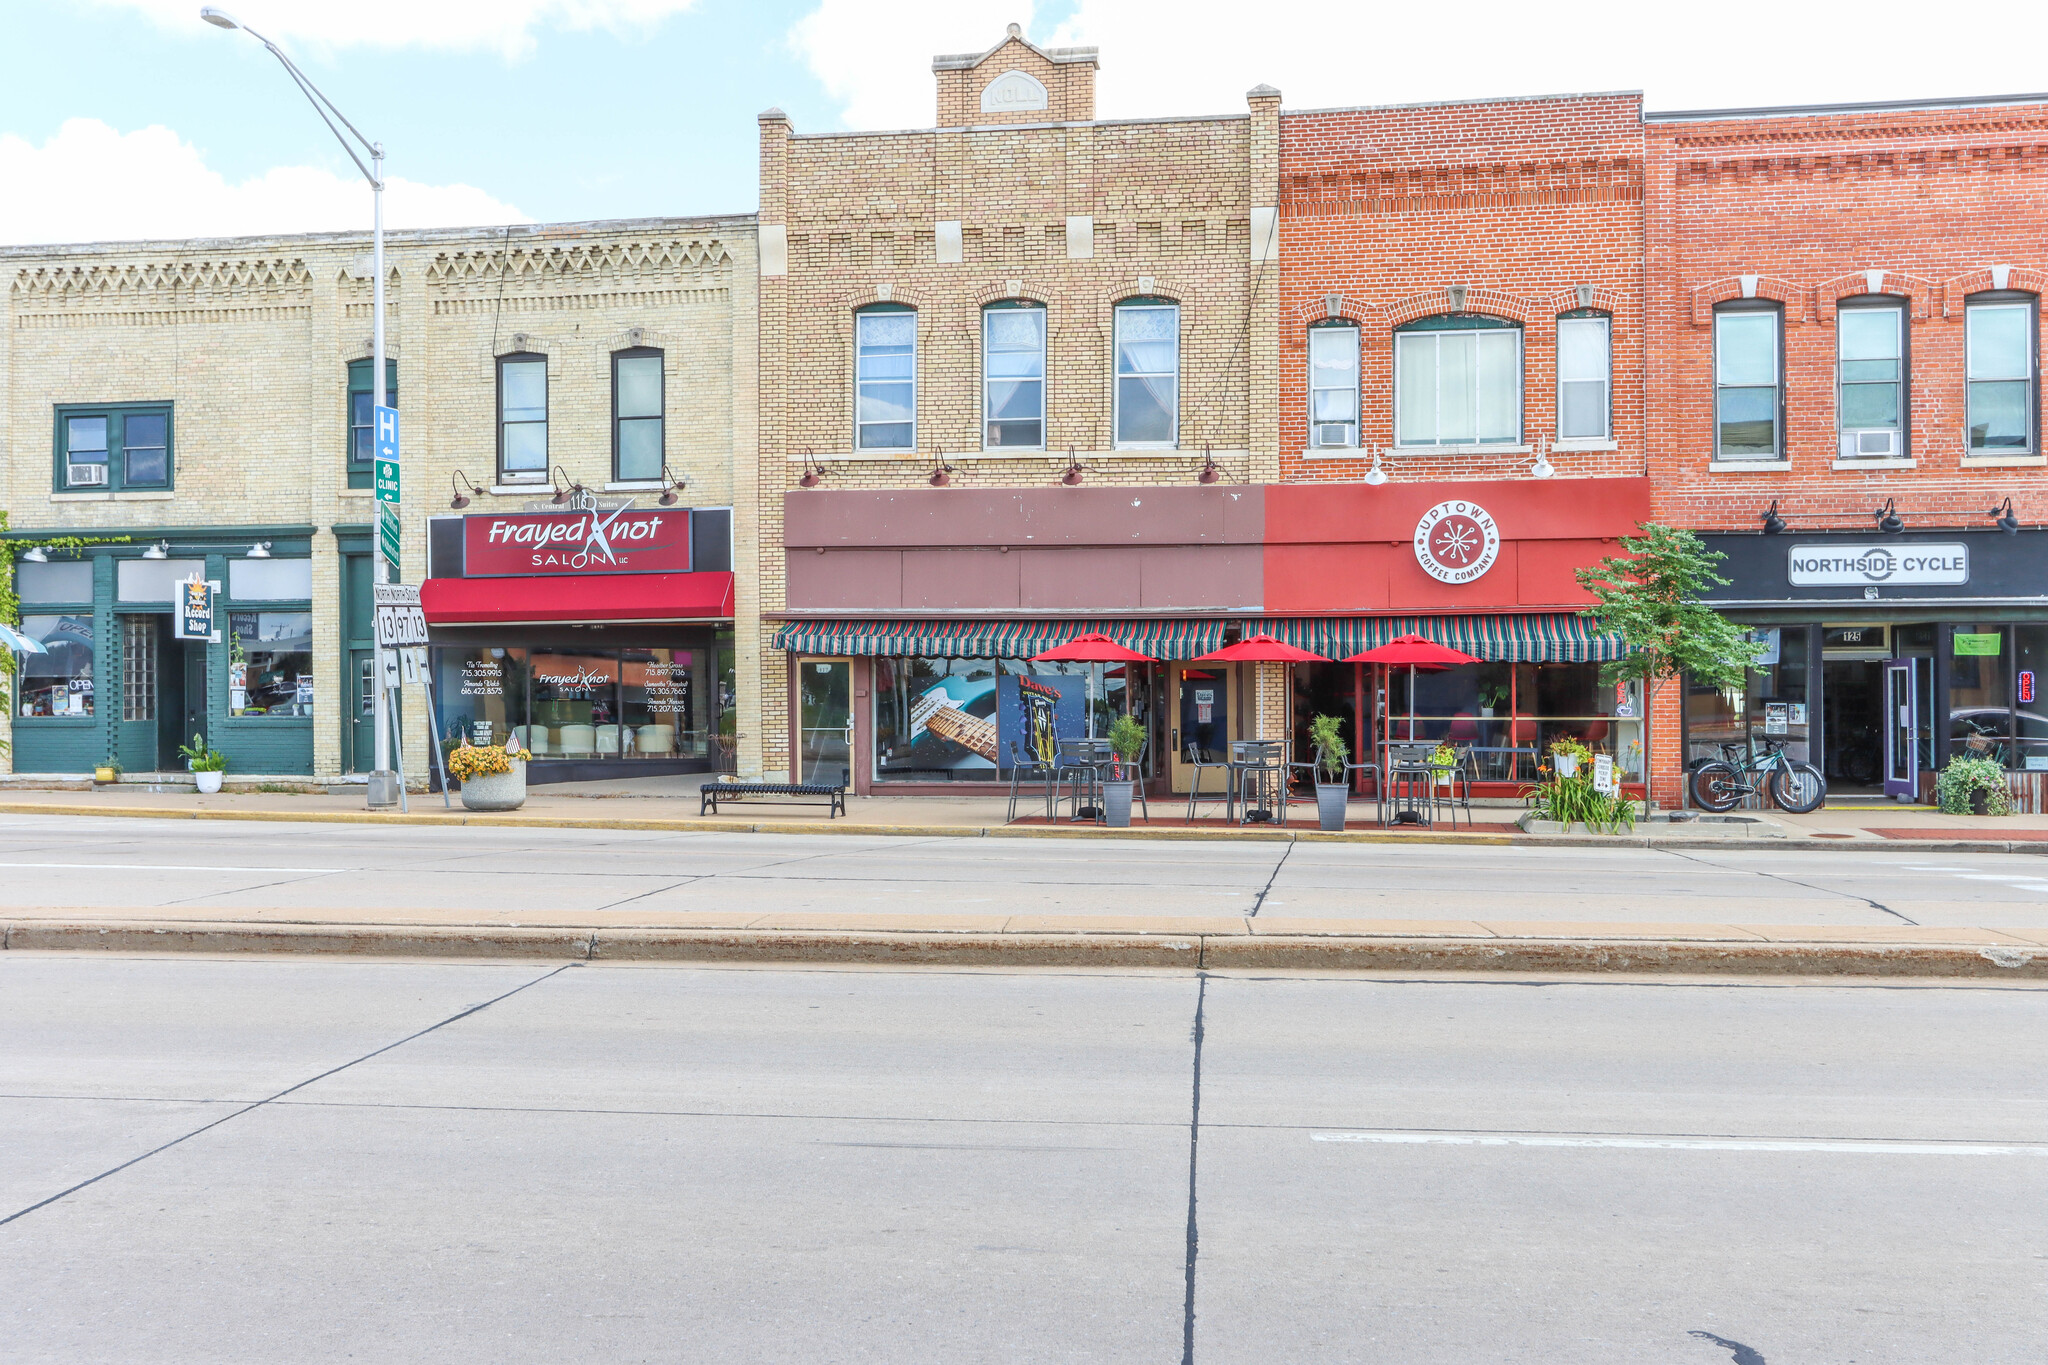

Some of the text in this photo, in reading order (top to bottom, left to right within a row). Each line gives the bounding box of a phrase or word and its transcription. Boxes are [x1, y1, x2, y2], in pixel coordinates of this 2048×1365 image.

[379, 411, 395, 443] H
[378, 478, 398, 492] CLINIC
[541, 501, 565, 510] Central
[1420, 503, 1493, 530] UPTOWN
[488, 517, 587, 550] Frayed
[531, 553, 607, 569] SALON
[1421, 553, 1492, 581] COFFEE COMPANY
[1793, 557, 1964, 572] NORTHSIDE CYCLE
[375, 587, 390, 600] NORTH
[390, 588, 405, 601] NORTH
[185, 606, 210, 619] Record
[188, 619, 207, 634] Shop
[382, 616, 394, 638] 13
[397, 616, 409, 638] 97
[413, 616, 425, 637] 13
[1844, 632, 1861, 641] 125
[461, 669, 503, 677] 715.305.9915
[539, 673, 580, 686] Frayed
[460, 687, 503, 695] 616.422.8575
[1018, 674, 1062, 699] Dave's
[2022, 672, 2030, 700] OPEN
[646, 705, 686, 713] 715.207.1625
